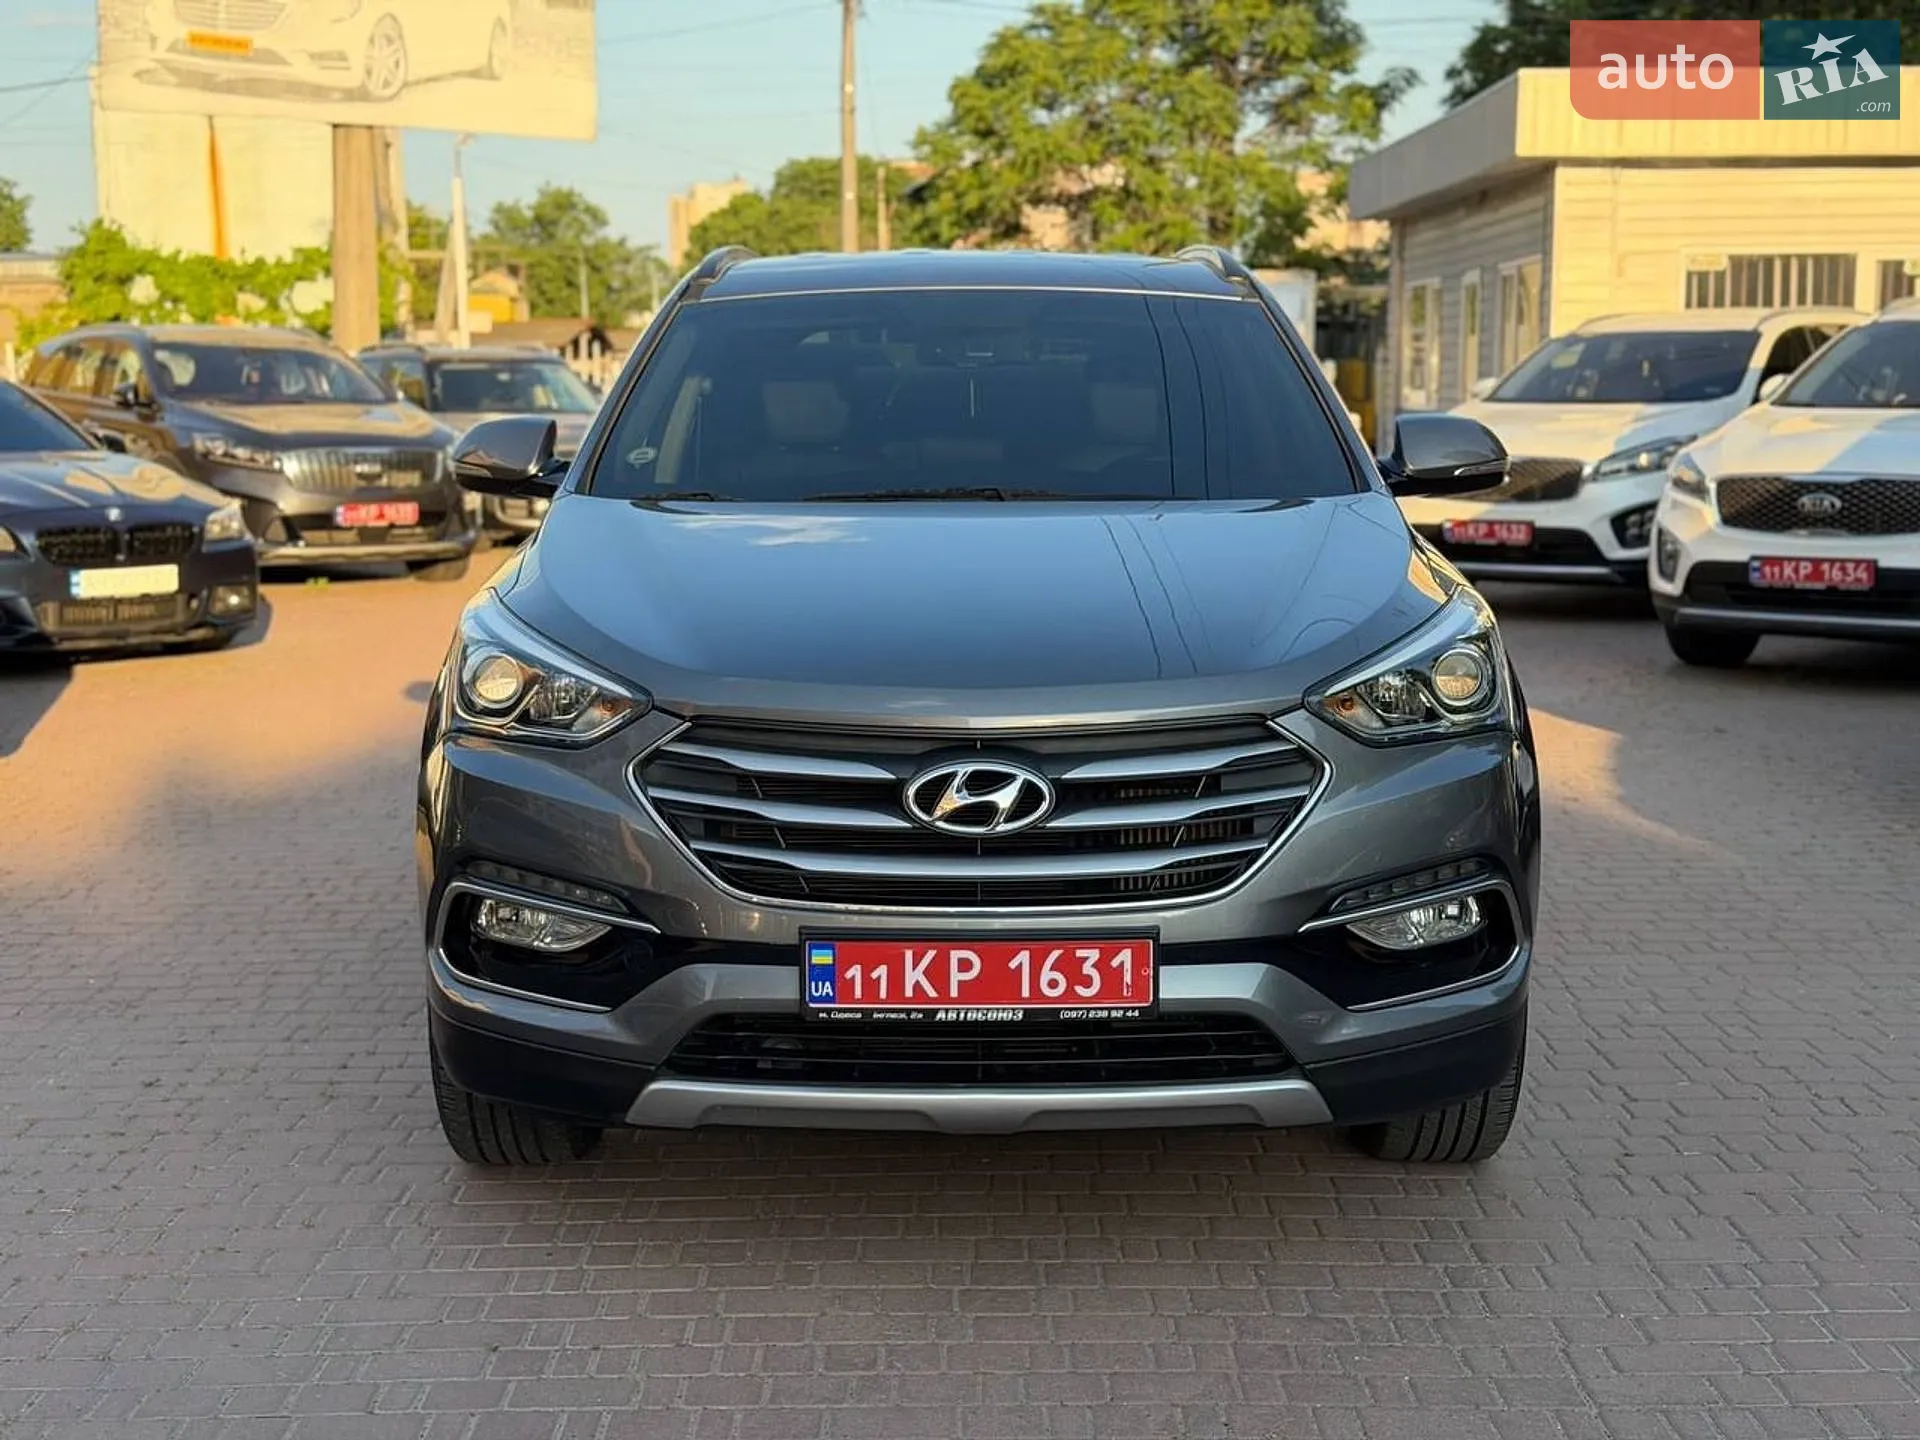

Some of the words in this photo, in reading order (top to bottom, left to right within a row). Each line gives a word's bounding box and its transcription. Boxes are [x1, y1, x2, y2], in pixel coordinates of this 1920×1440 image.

[1820, 561, 1868, 583] 1634
[1007, 947, 1133, 998] 1631
[810, 980, 834, 997] UA
[1060, 1009, 1087, 1020] (097)
[1126, 1008, 1140, 1018] 44
